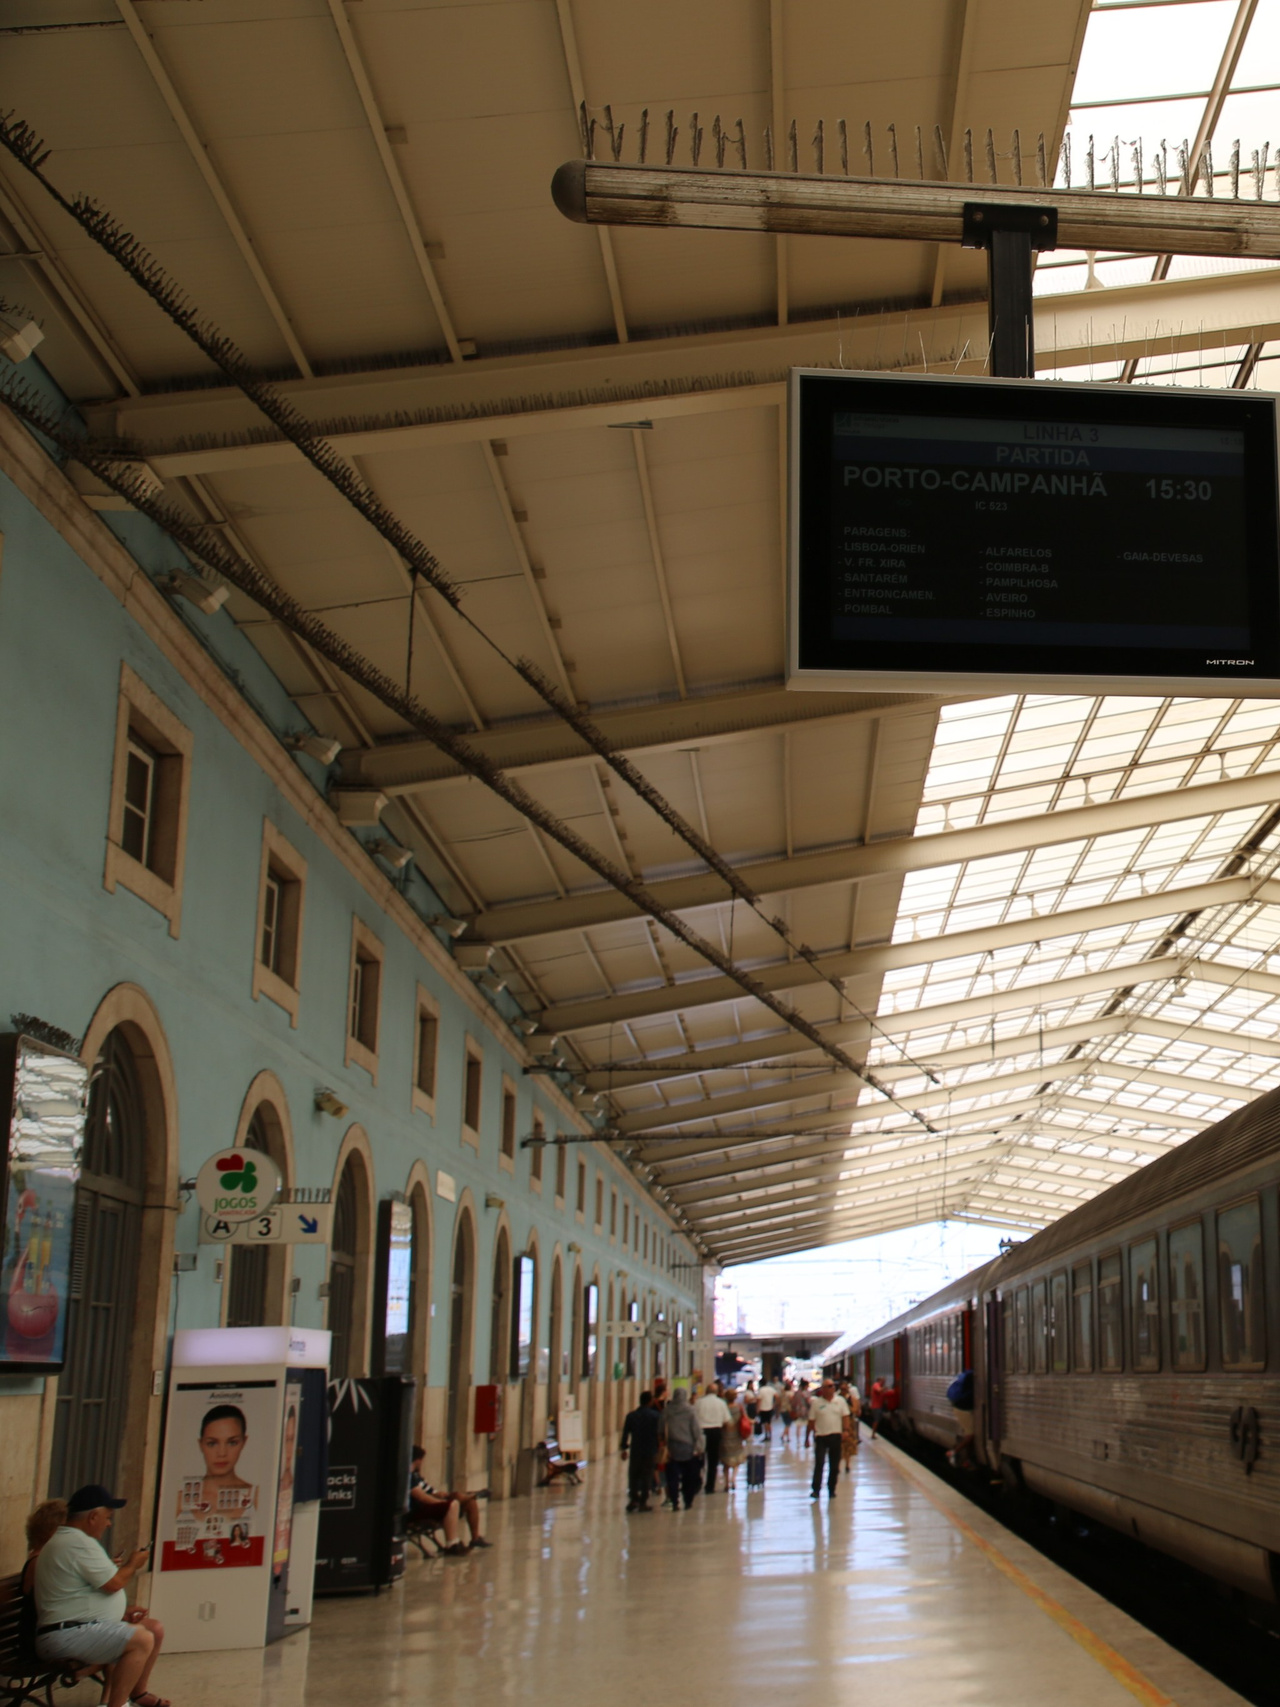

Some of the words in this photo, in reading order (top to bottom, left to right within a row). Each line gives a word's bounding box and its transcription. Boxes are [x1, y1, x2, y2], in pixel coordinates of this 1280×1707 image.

[1023, 424, 1083, 442] LINHA
[1089, 427, 1100, 443] 3
[996, 445, 1091, 467] PARTIDA
[843, 465, 1109, 498] PORTO-CAMPANHÃ
[1145, 478, 1212, 501] 15:30
[974, 500, 987, 511] IC
[989, 501, 1009, 512] 523
[843, 526, 911, 538] PARAGENS:
[844, 542, 926, 554] LISBOA-ORIEN
[985, 546, 1053, 558] ALFARELOS
[1123, 551, 1204, 563] GAIA-DEVESAS
[844, 558, 855, 567] V.
[858, 558, 876, 568] FR.
[879, 558, 907, 569] XIRA
[985, 562, 1050, 573] COIMBRA-B
[844, 571, 909, 584] SANTARÉM
[985, 577, 1059, 589] PAMPILHOSA
[844, 588, 937, 600] ENTRONCAMEN.
[986, 593, 1029, 603] AVEIRO
[844, 604, 893, 615] POMBAL
[986, 608, 1036, 619] ESPINHO
[1205, 658, 1256, 667] MITRON
[214, 1197, 258, 1213] JOGOS
[212, 1220, 231, 1234] A
[258, 1217, 272, 1237] 3
[326, 1474, 357, 1486] acks
[327, 1489, 353, 1500] inks
